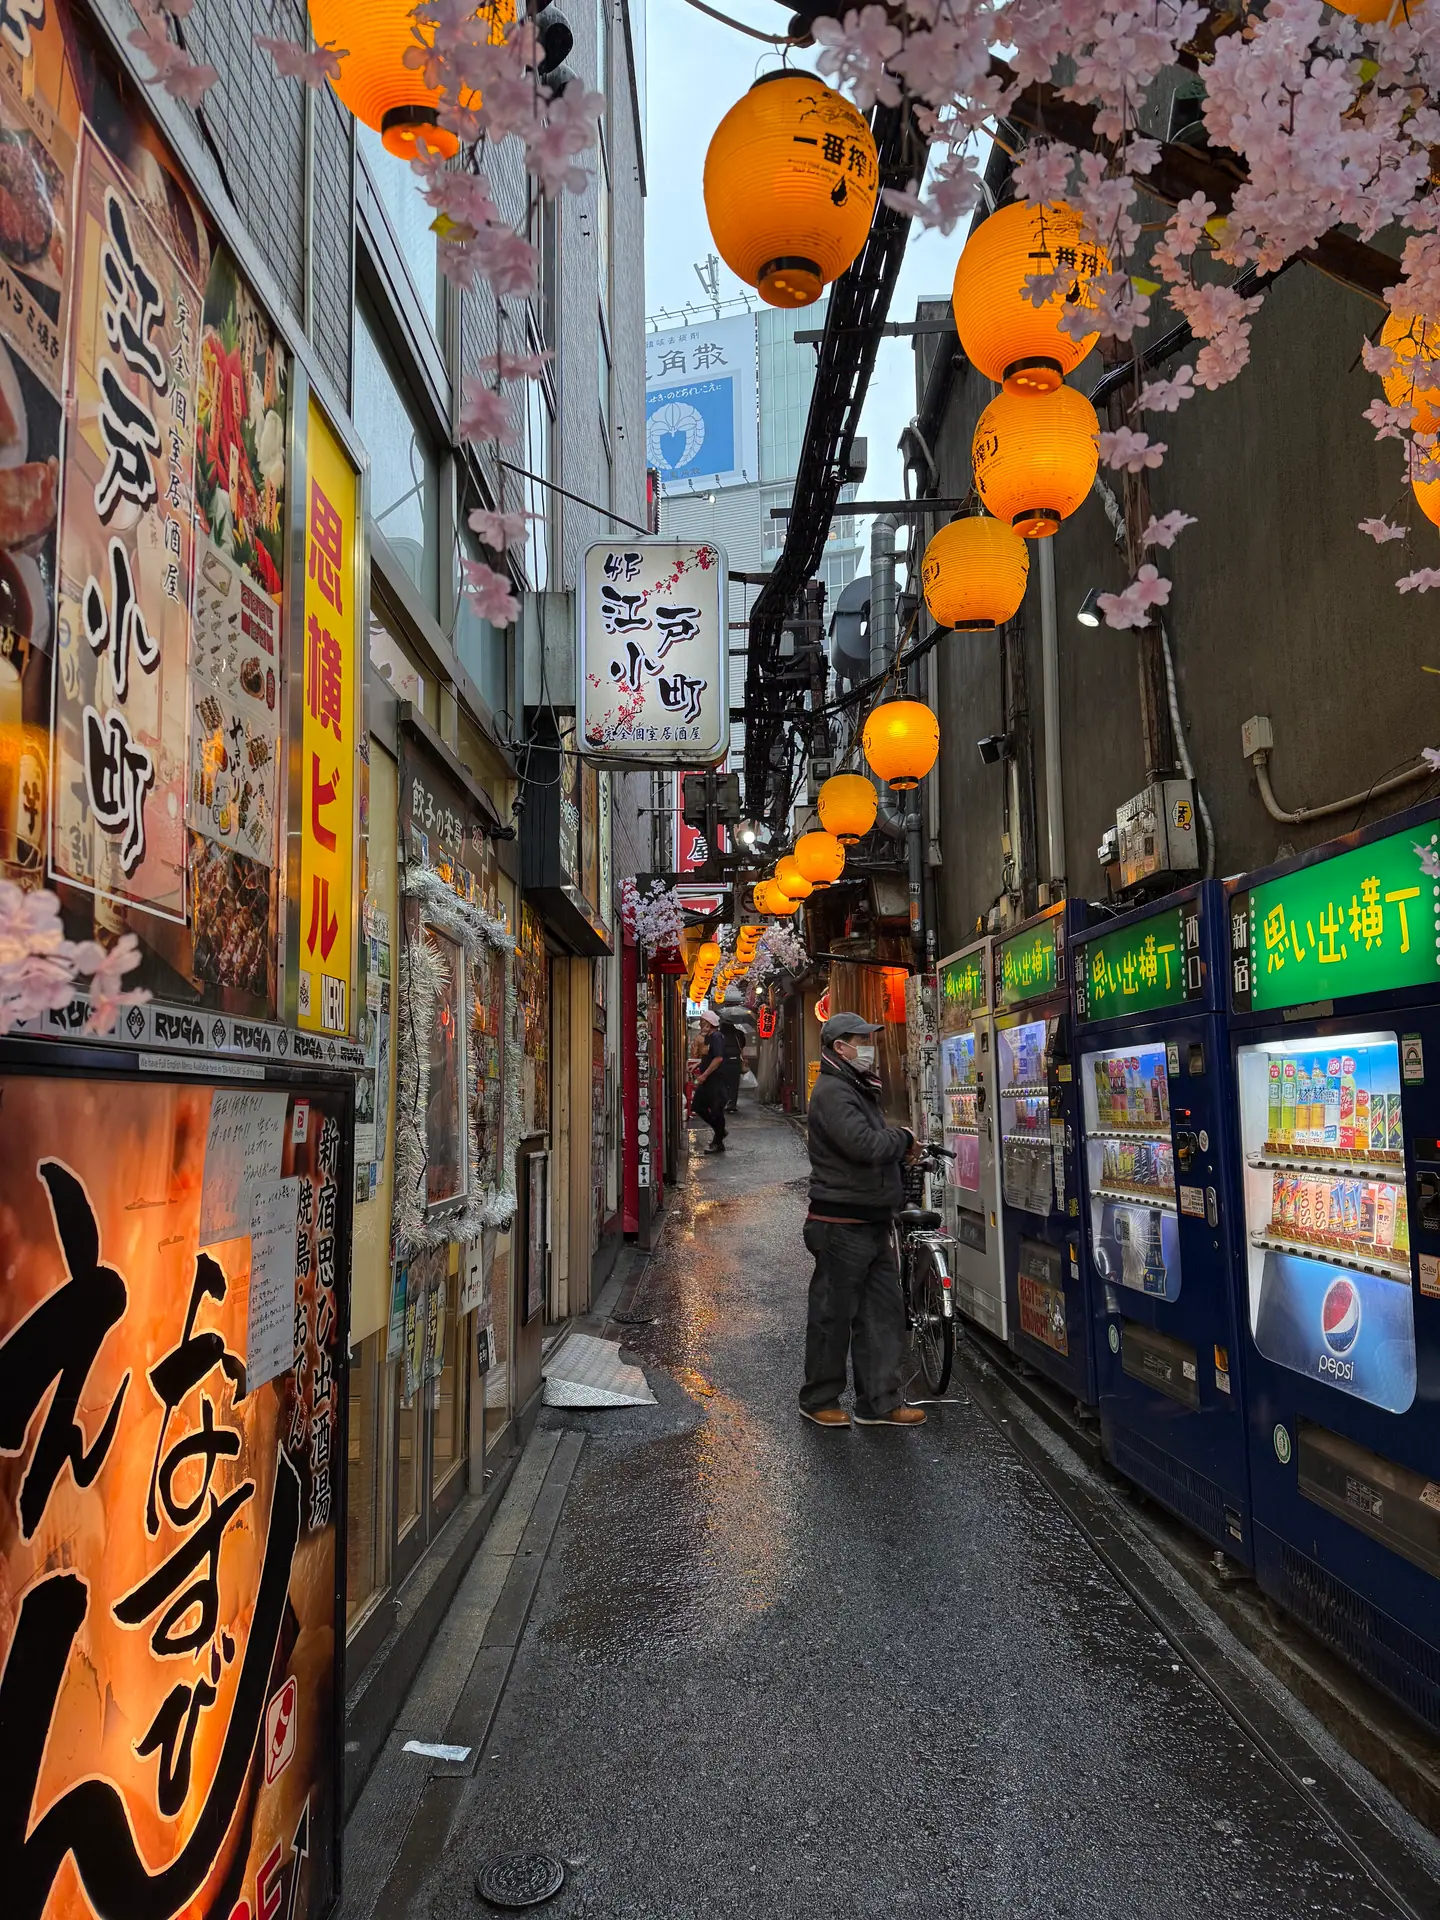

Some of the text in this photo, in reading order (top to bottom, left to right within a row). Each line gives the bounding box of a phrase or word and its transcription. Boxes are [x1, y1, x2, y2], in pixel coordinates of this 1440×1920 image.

[646, 343, 729, 382] 角散
[306, 476, 342, 964] 思横ビル
[604, 726, 702, 742] 完全個室居酒屋
[1262, 876, 1421, 975] 思い出横丁
[1004, 938, 1053, 991] 思い出横丁
[1092, 934, 1176, 1001] 思い出横丁
[1186, 914, 1202, 990] 西口
[1231, 911, 1250, 994] 新宿
[322, 975, 346, 1032] NERO
[155, 1012, 205, 1046] RUGA
[233, 1025, 272, 1054] RUGA
[294, 1034, 323, 1060] RUGA
[1301, 1188, 1312, 1226] BOSS
[1315, 1190, 1326, 1229] BOSS
[309, 1118, 340, 1528] 新宿思ひ出酒場
[1317, 1353, 1356, 1383] pepsi
